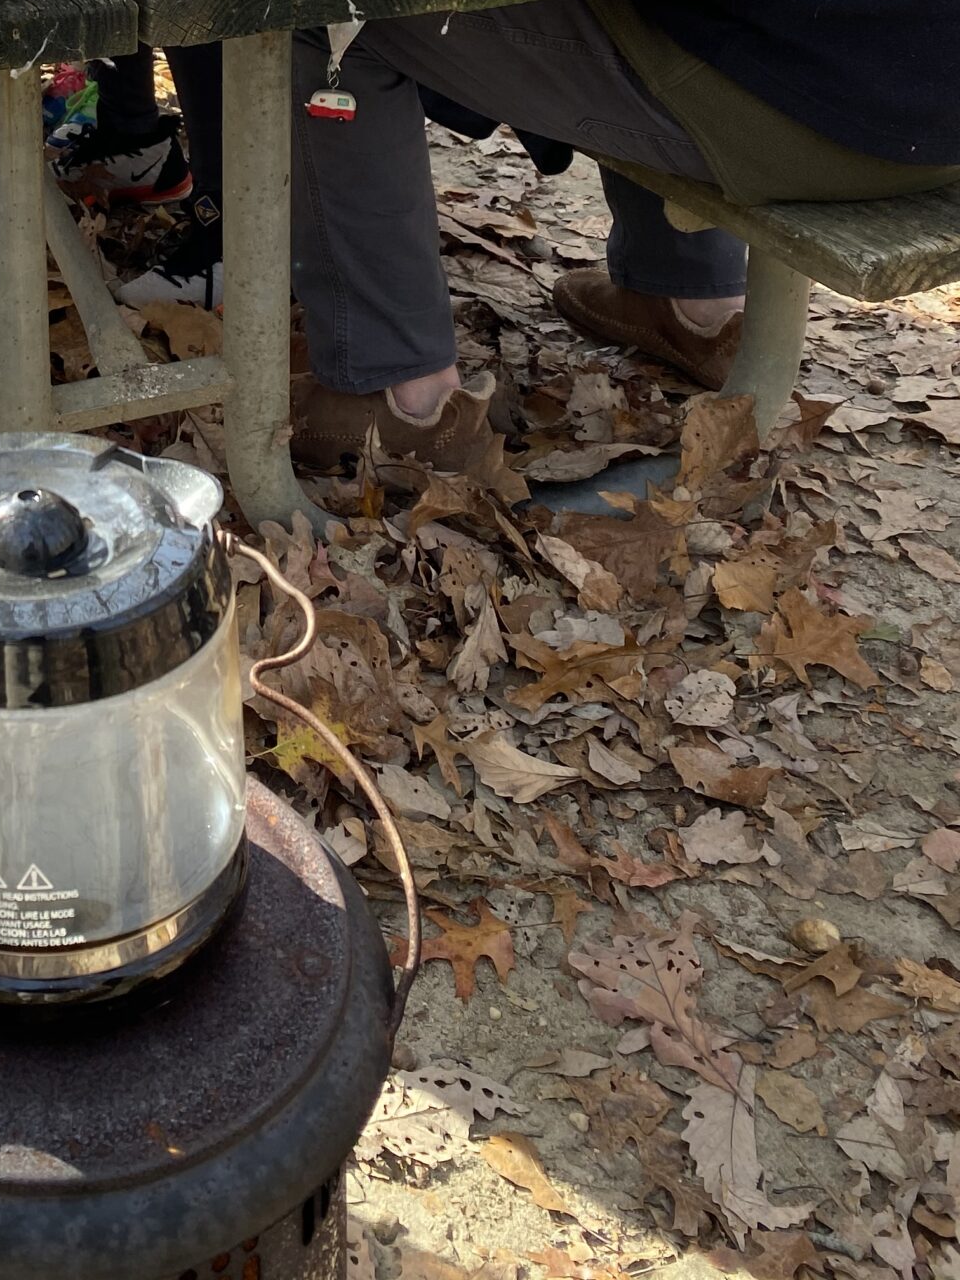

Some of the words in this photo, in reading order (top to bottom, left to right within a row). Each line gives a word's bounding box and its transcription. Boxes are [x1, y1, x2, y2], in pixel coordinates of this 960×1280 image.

[24, 889, 80, 902] INSTRUCTIONS
[39, 910, 50, 920] LE
[50, 908, 75, 919] MODE
[31, 928, 49, 939] LEA
[49, 927, 67, 938] LAS
[20, 937, 47, 947] ANTES
[48, 936, 61, 947] DE
